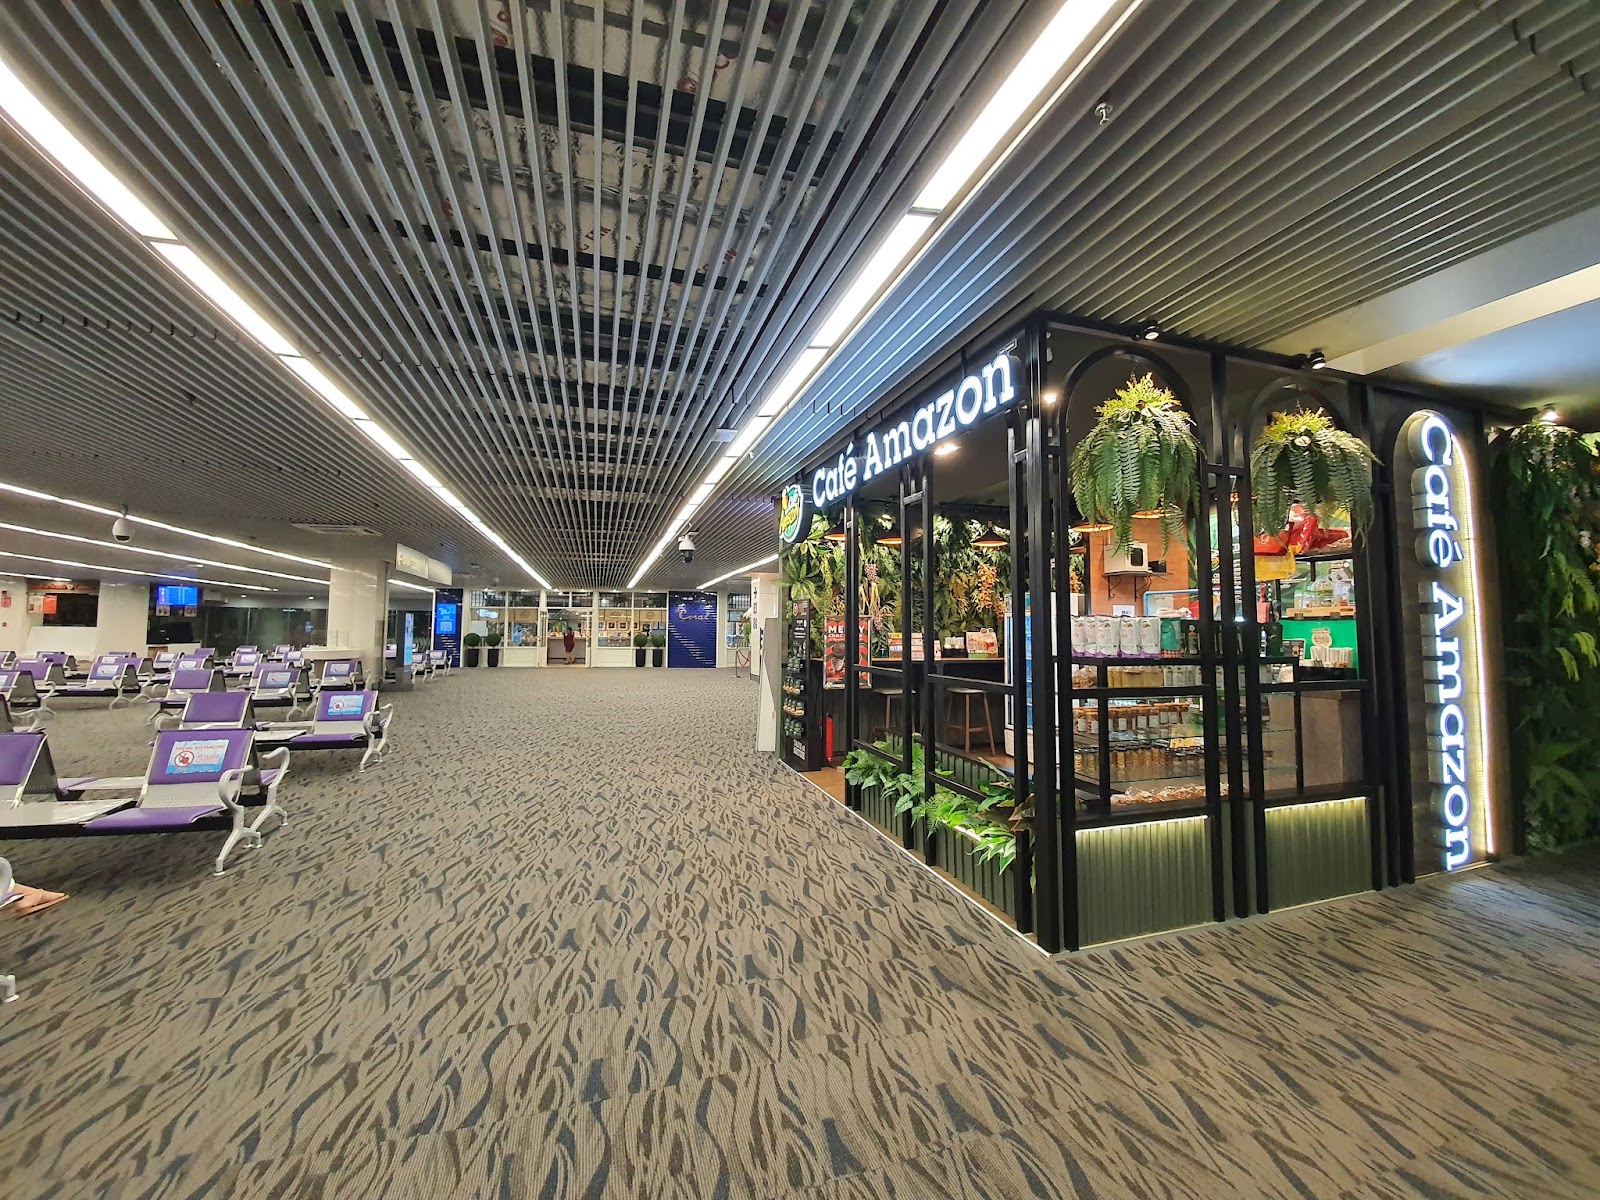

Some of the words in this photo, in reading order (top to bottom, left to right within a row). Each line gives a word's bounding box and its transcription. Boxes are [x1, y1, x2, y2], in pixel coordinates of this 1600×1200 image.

[812, 441, 857, 508] Café
[863, 354, 1015, 482] Amazon
[1420, 415, 1463, 569] Café
[677, 606, 710, 621] Coral
[1431, 581, 1471, 872] Amazon
